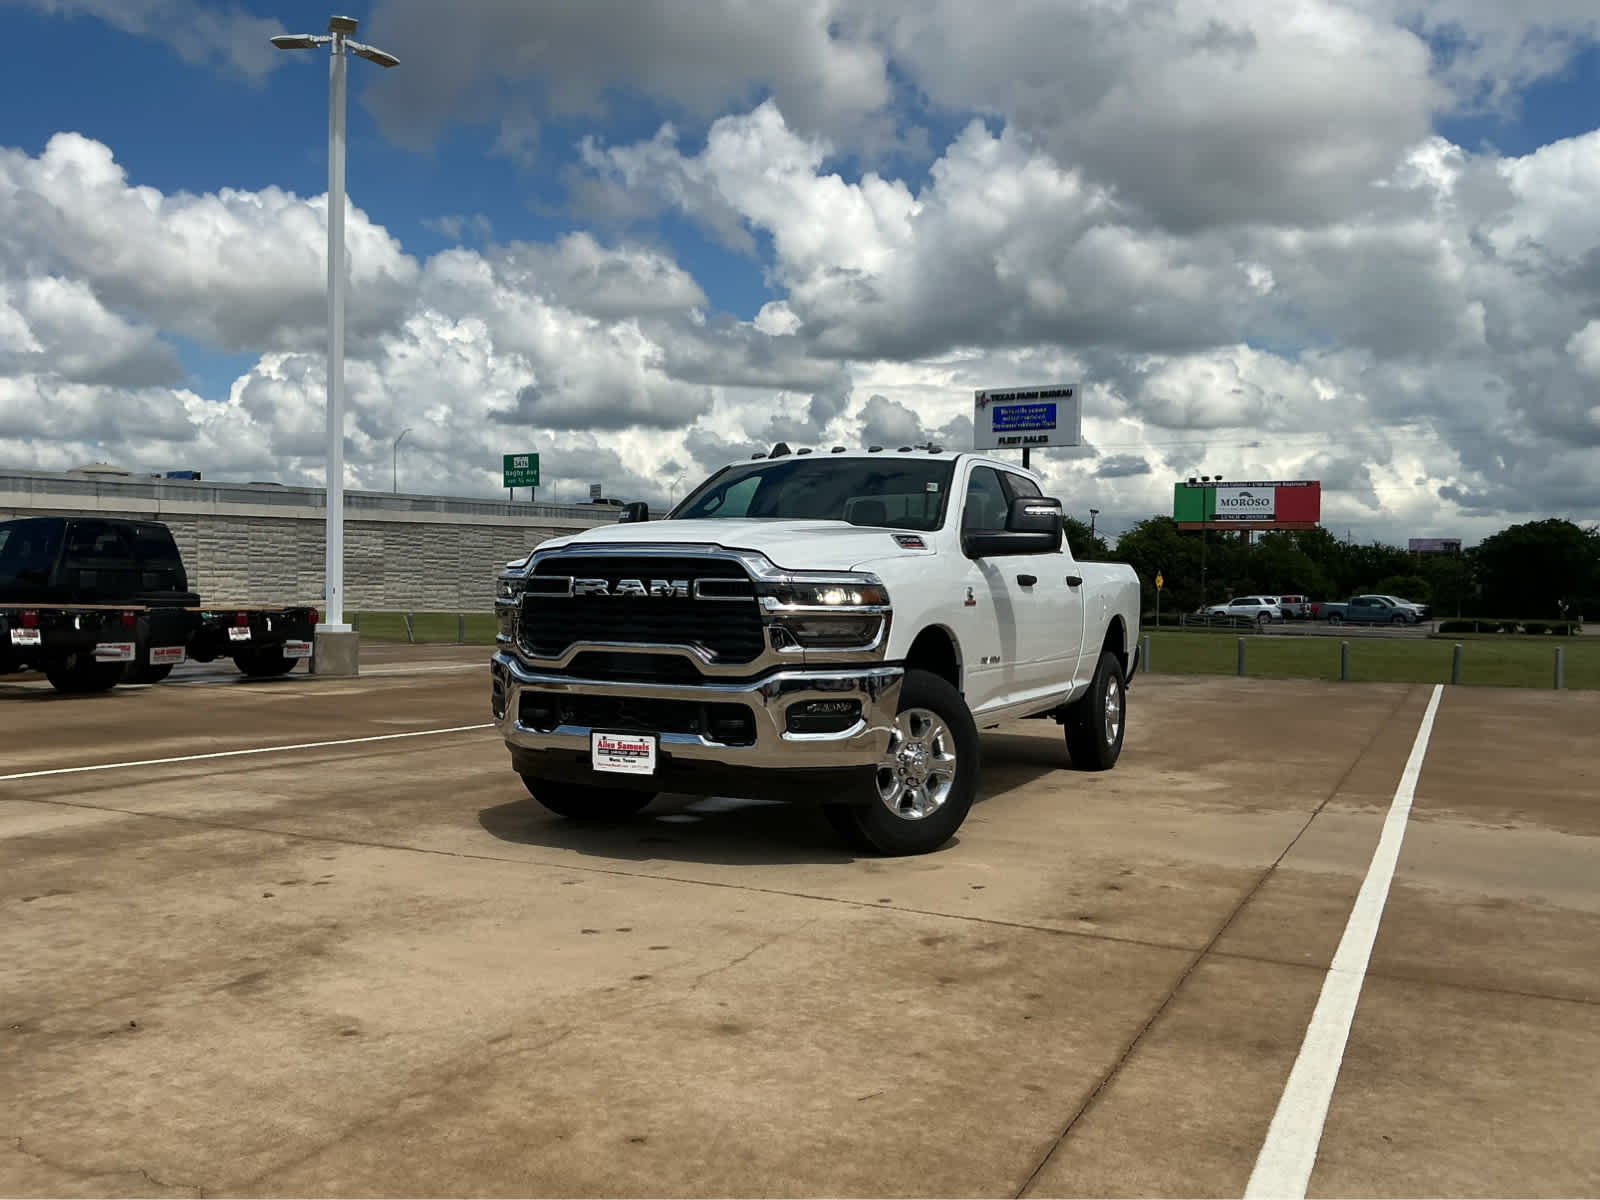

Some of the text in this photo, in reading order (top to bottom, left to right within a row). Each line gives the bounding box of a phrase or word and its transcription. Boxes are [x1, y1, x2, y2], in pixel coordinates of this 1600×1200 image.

[991, 389, 1073, 401] TEXAS FARM BUREAU
[998, 435, 1048, 445] FLEET SALES
[1220, 498, 1270, 507] MOROSO
[574, 578, 689, 598] RAM
[598, 740, 649, 751] Allen Samuels
